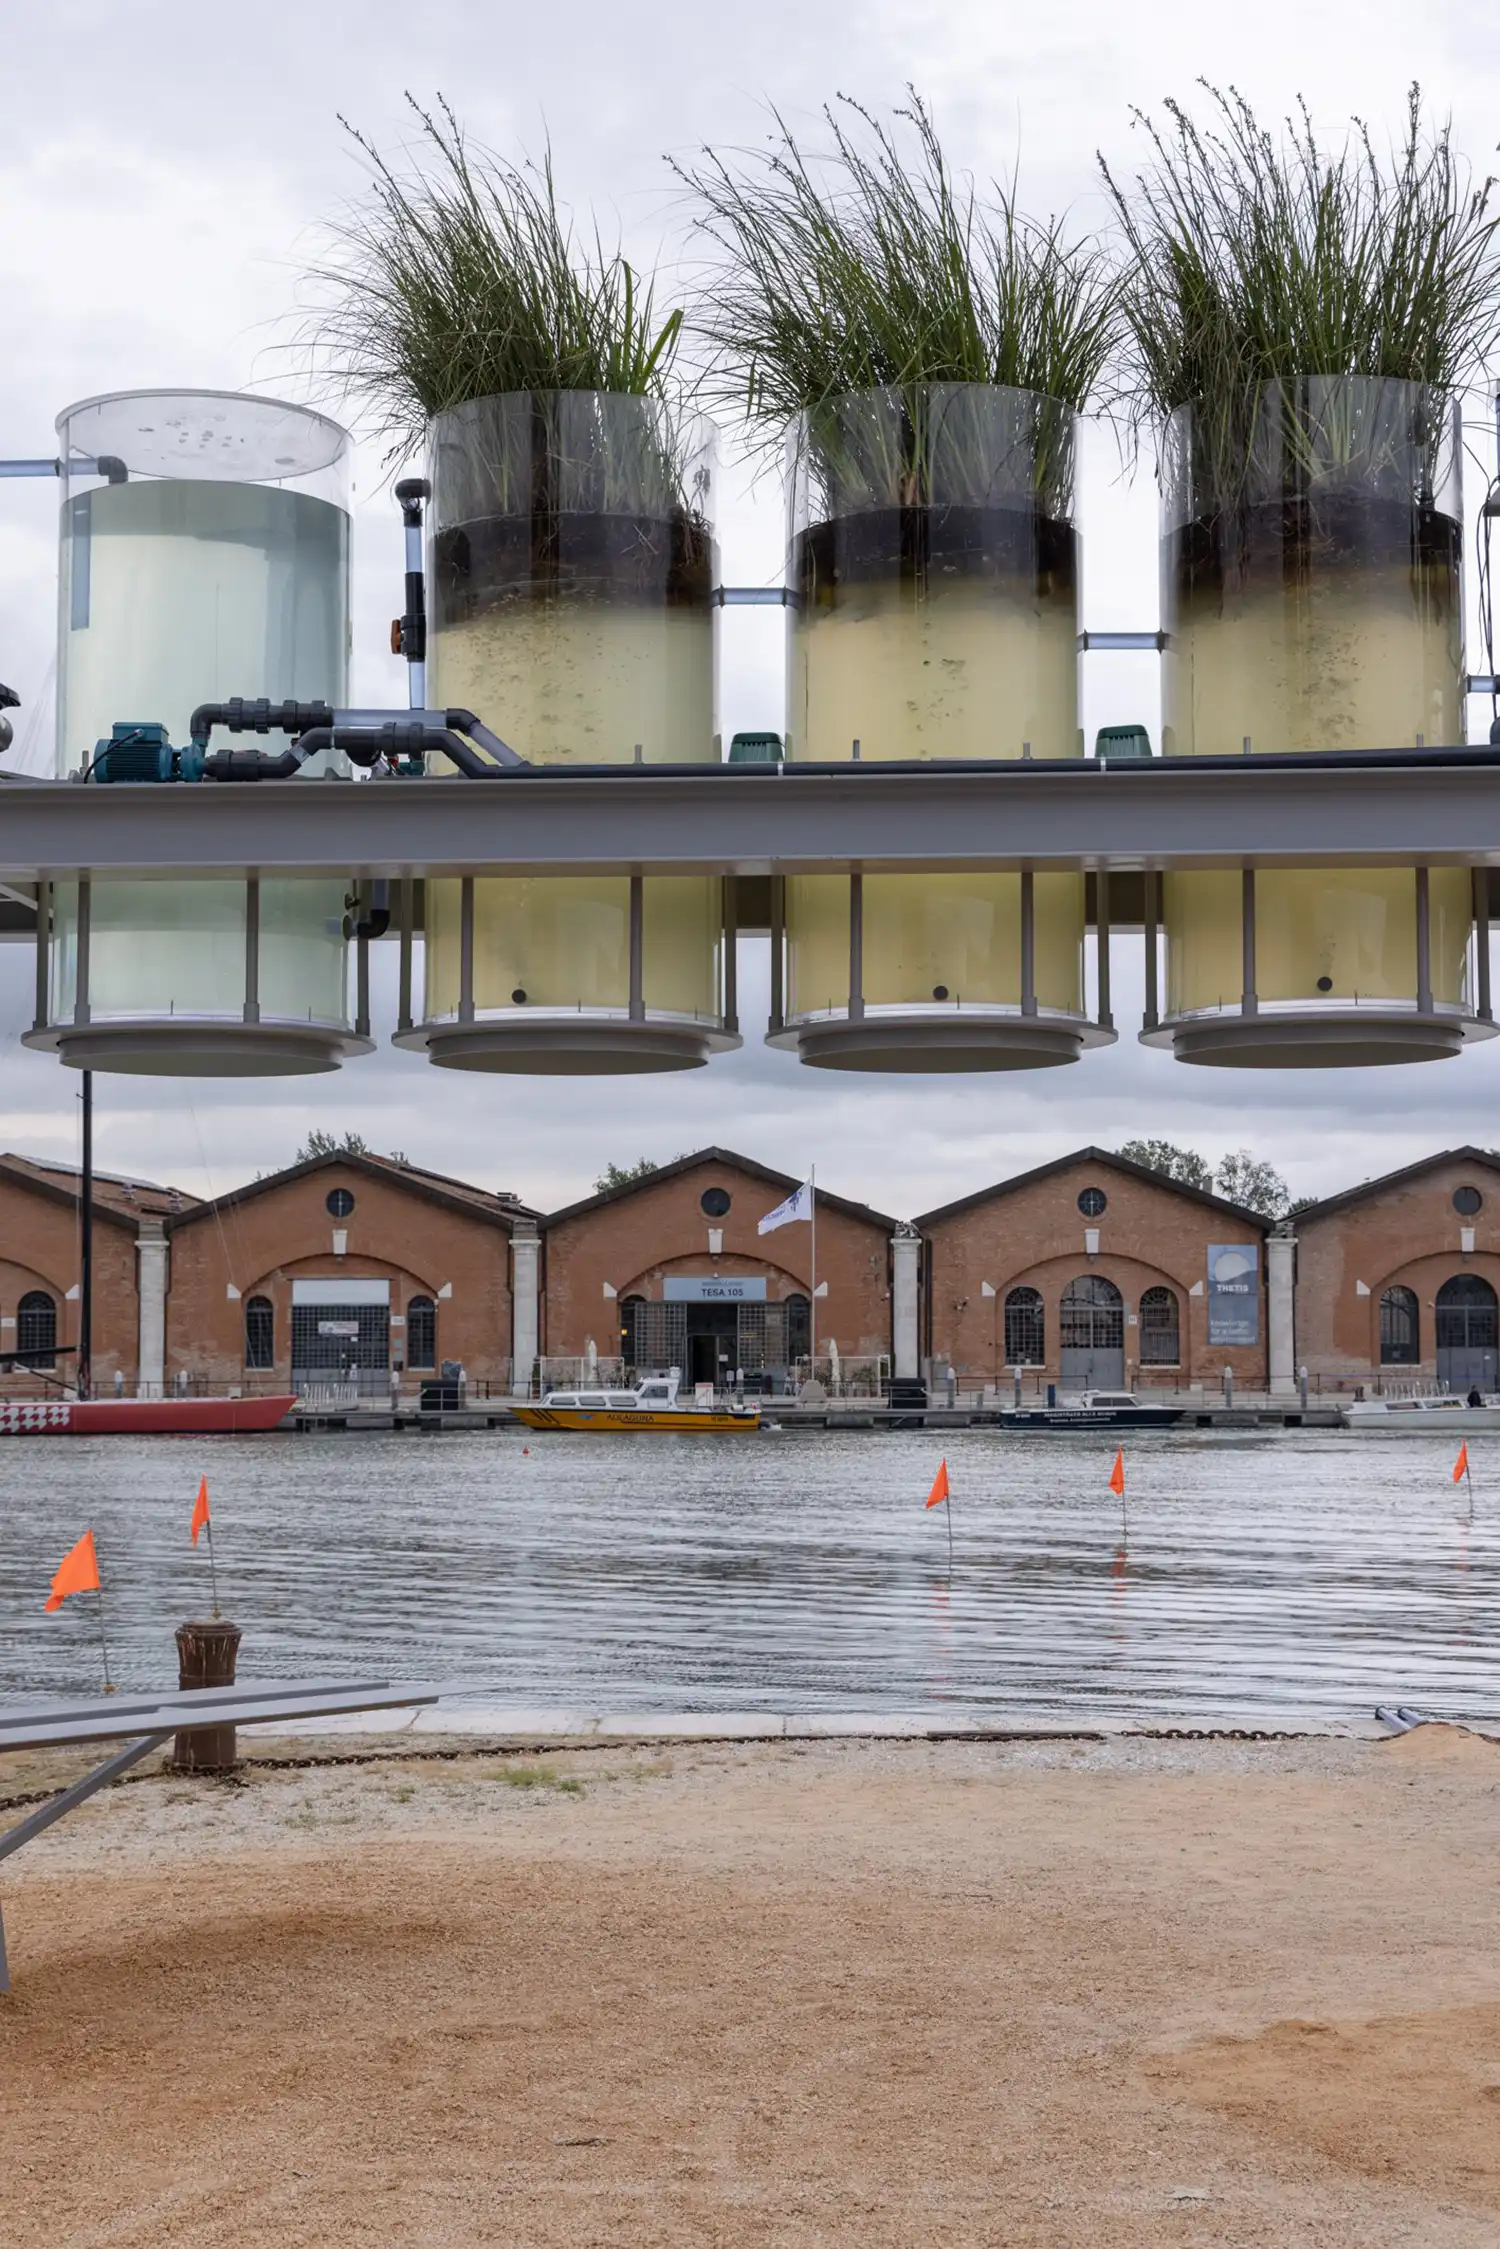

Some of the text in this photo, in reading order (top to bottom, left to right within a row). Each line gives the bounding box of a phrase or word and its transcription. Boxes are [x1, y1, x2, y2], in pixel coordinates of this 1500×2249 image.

[1216, 1284, 1249, 1292] THETIS
[701, 1288, 744, 1297] TESA 105
